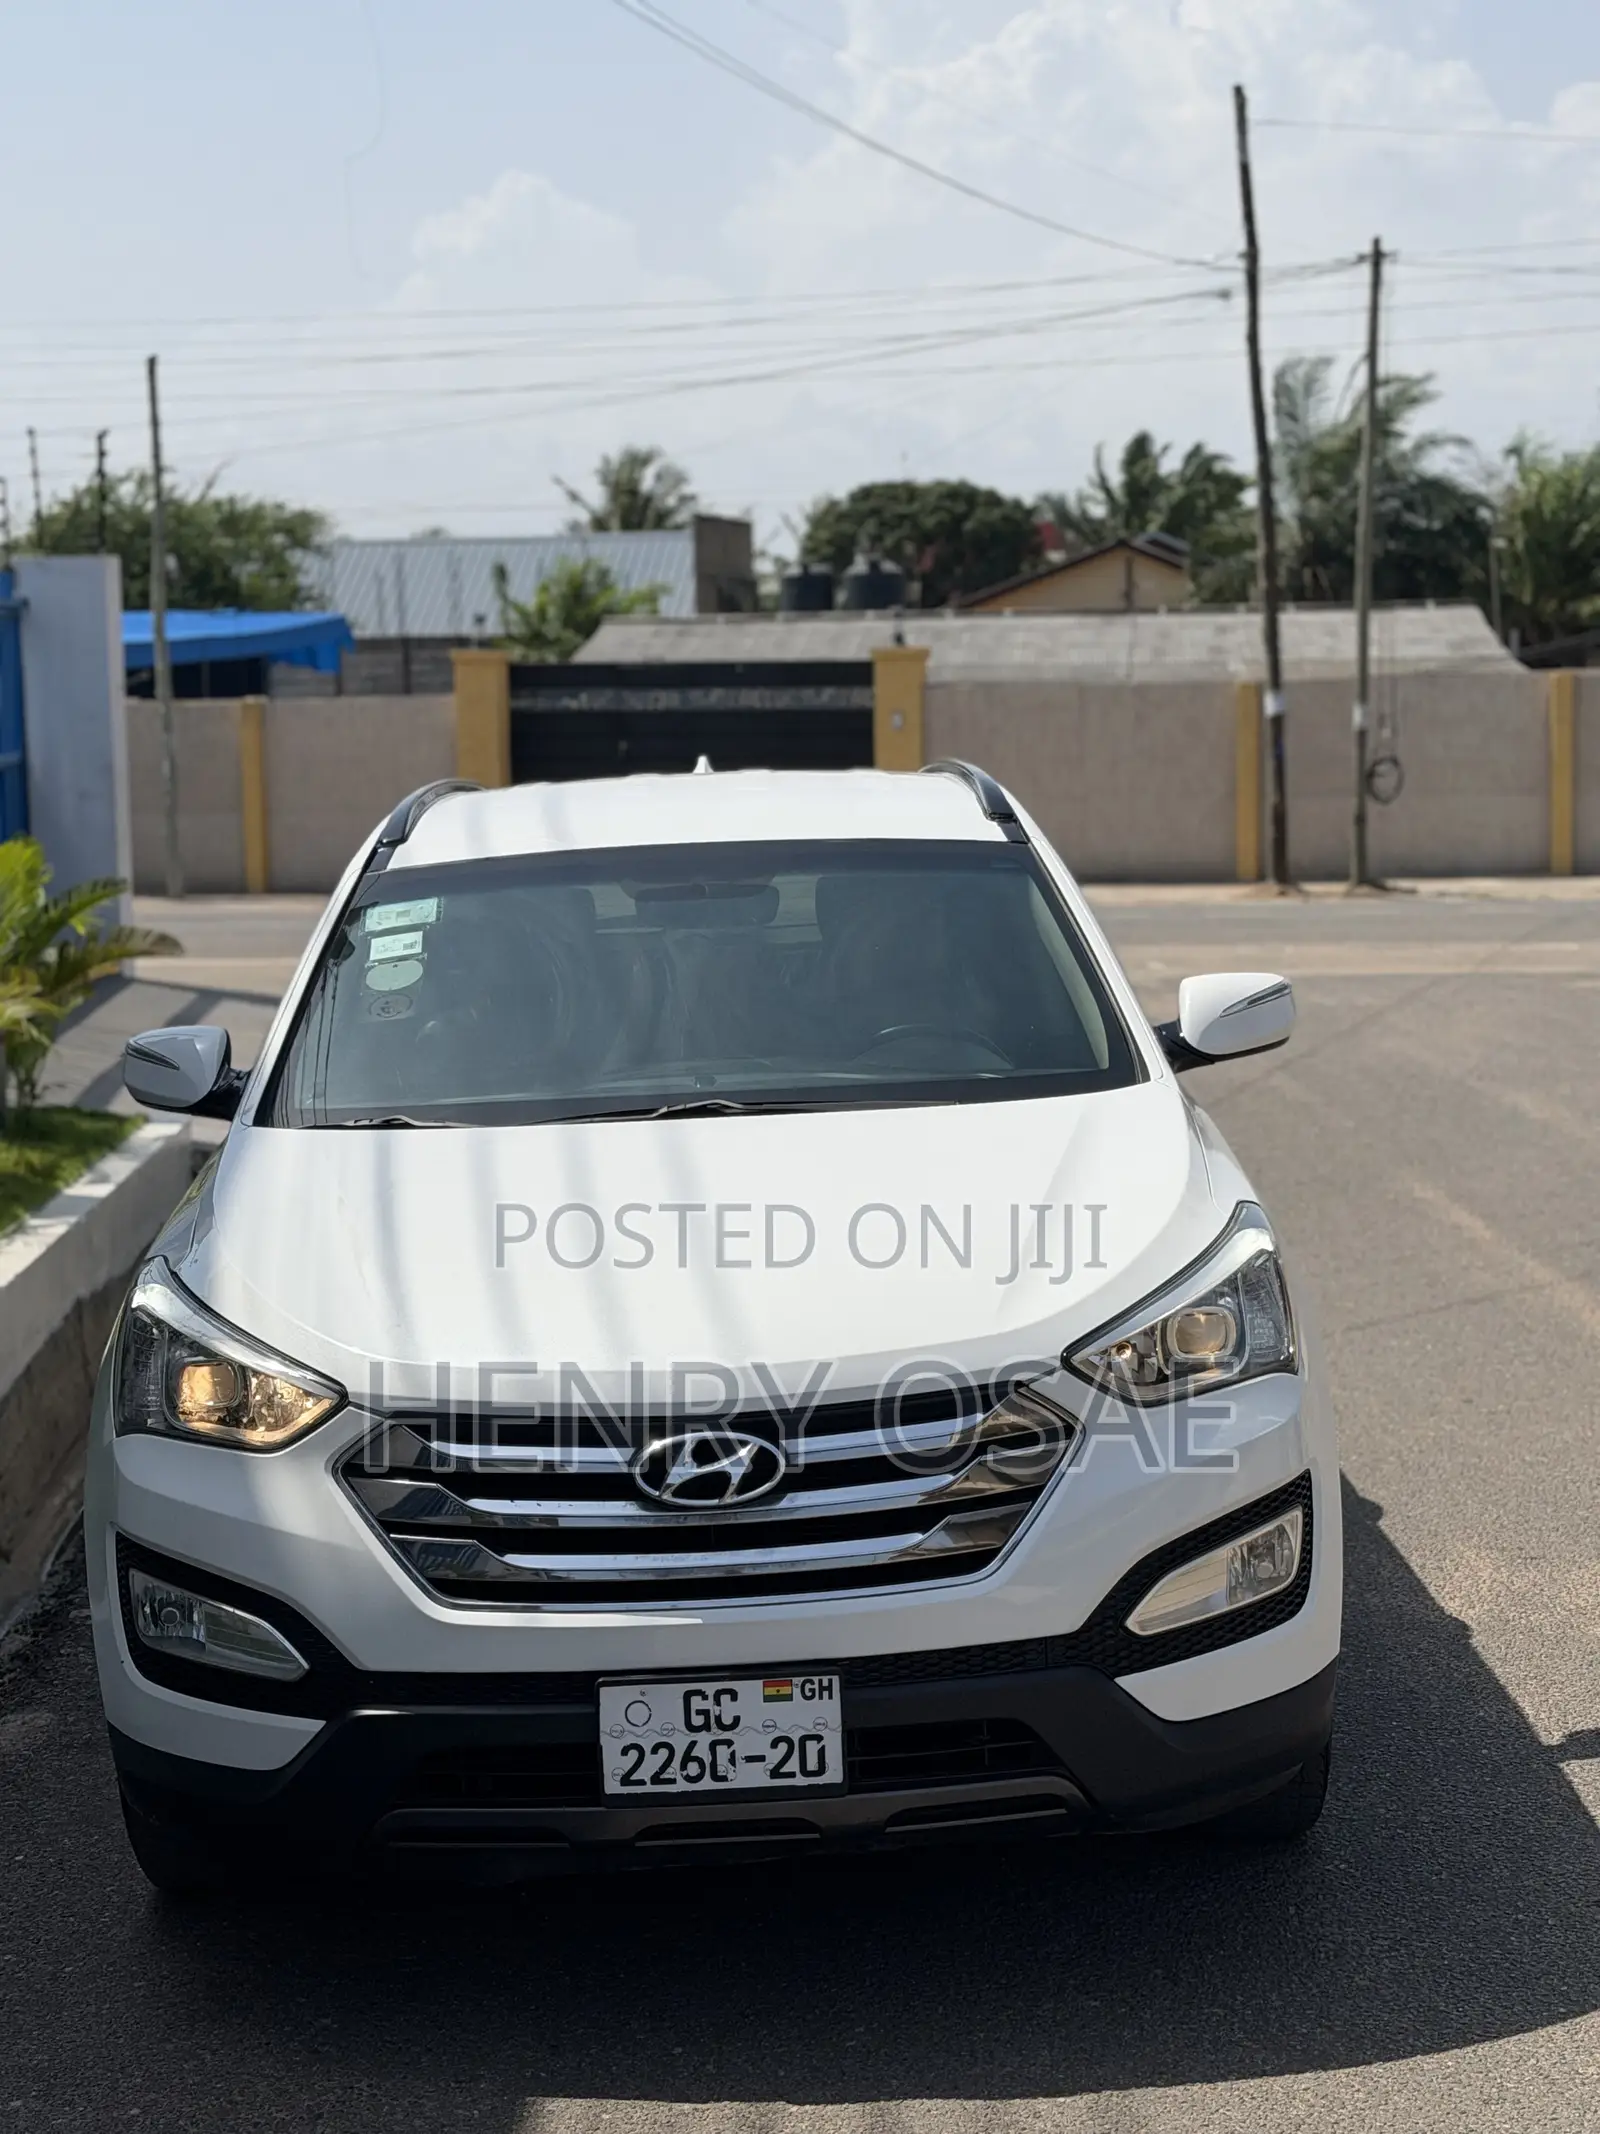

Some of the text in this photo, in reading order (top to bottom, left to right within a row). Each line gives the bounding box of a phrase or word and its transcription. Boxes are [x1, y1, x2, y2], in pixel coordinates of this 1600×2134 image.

[683, 1688, 740, 1733] GC
[800, 1678, 833, 1701] GH
[620, 1733, 826, 1787] 2260-20
